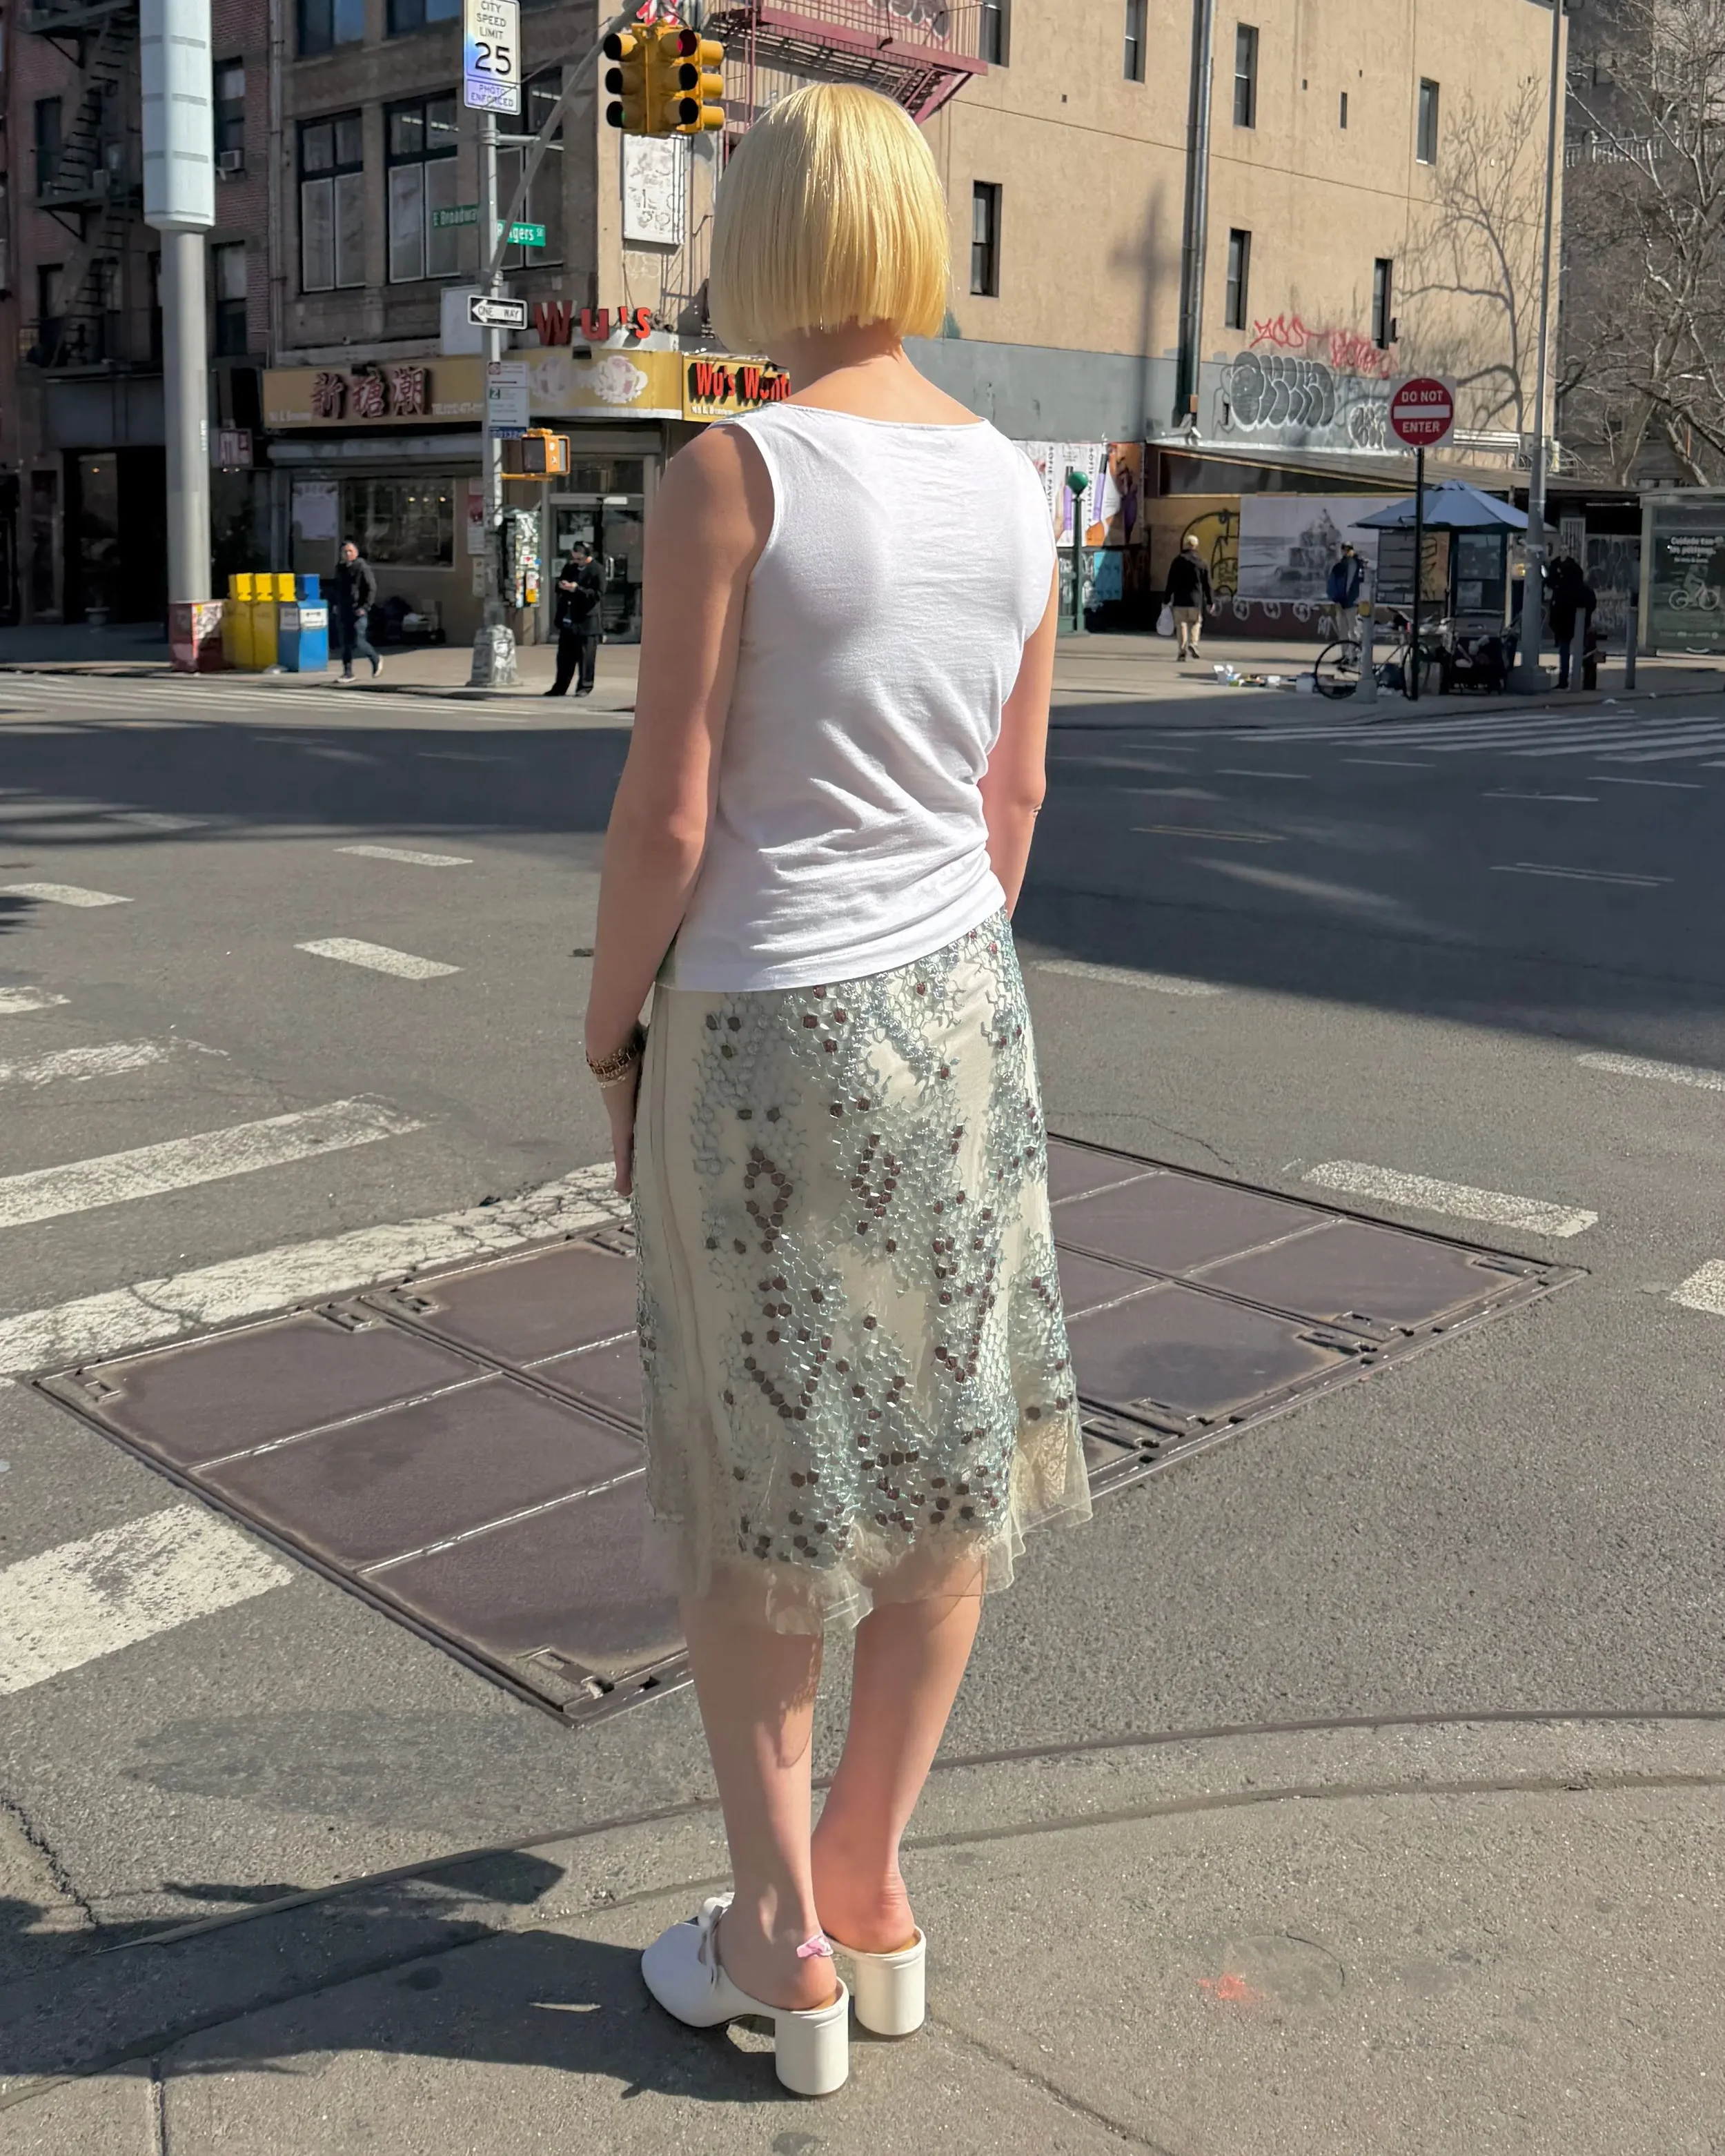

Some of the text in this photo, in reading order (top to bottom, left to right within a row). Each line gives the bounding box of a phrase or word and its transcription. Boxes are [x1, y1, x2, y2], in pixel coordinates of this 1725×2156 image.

[481, 1, 502, 13] CITY
[476, 13, 506, 27] SPEED
[480, 26, 504, 39] LIMIT
[475, 41, 511, 76] 25
[479, 84, 506, 96] PHOTO
[471, 92, 514, 107] ENFORCED
[440, 208, 477, 226] Broadwa
[477, 306, 520, 319] ONE WAY
[533, 299, 652, 346] Wu's
[696, 362, 736, 397] Wu's
[1401, 390, 1443, 402] DO NOT
[1402, 421, 1441, 433] ENTER
